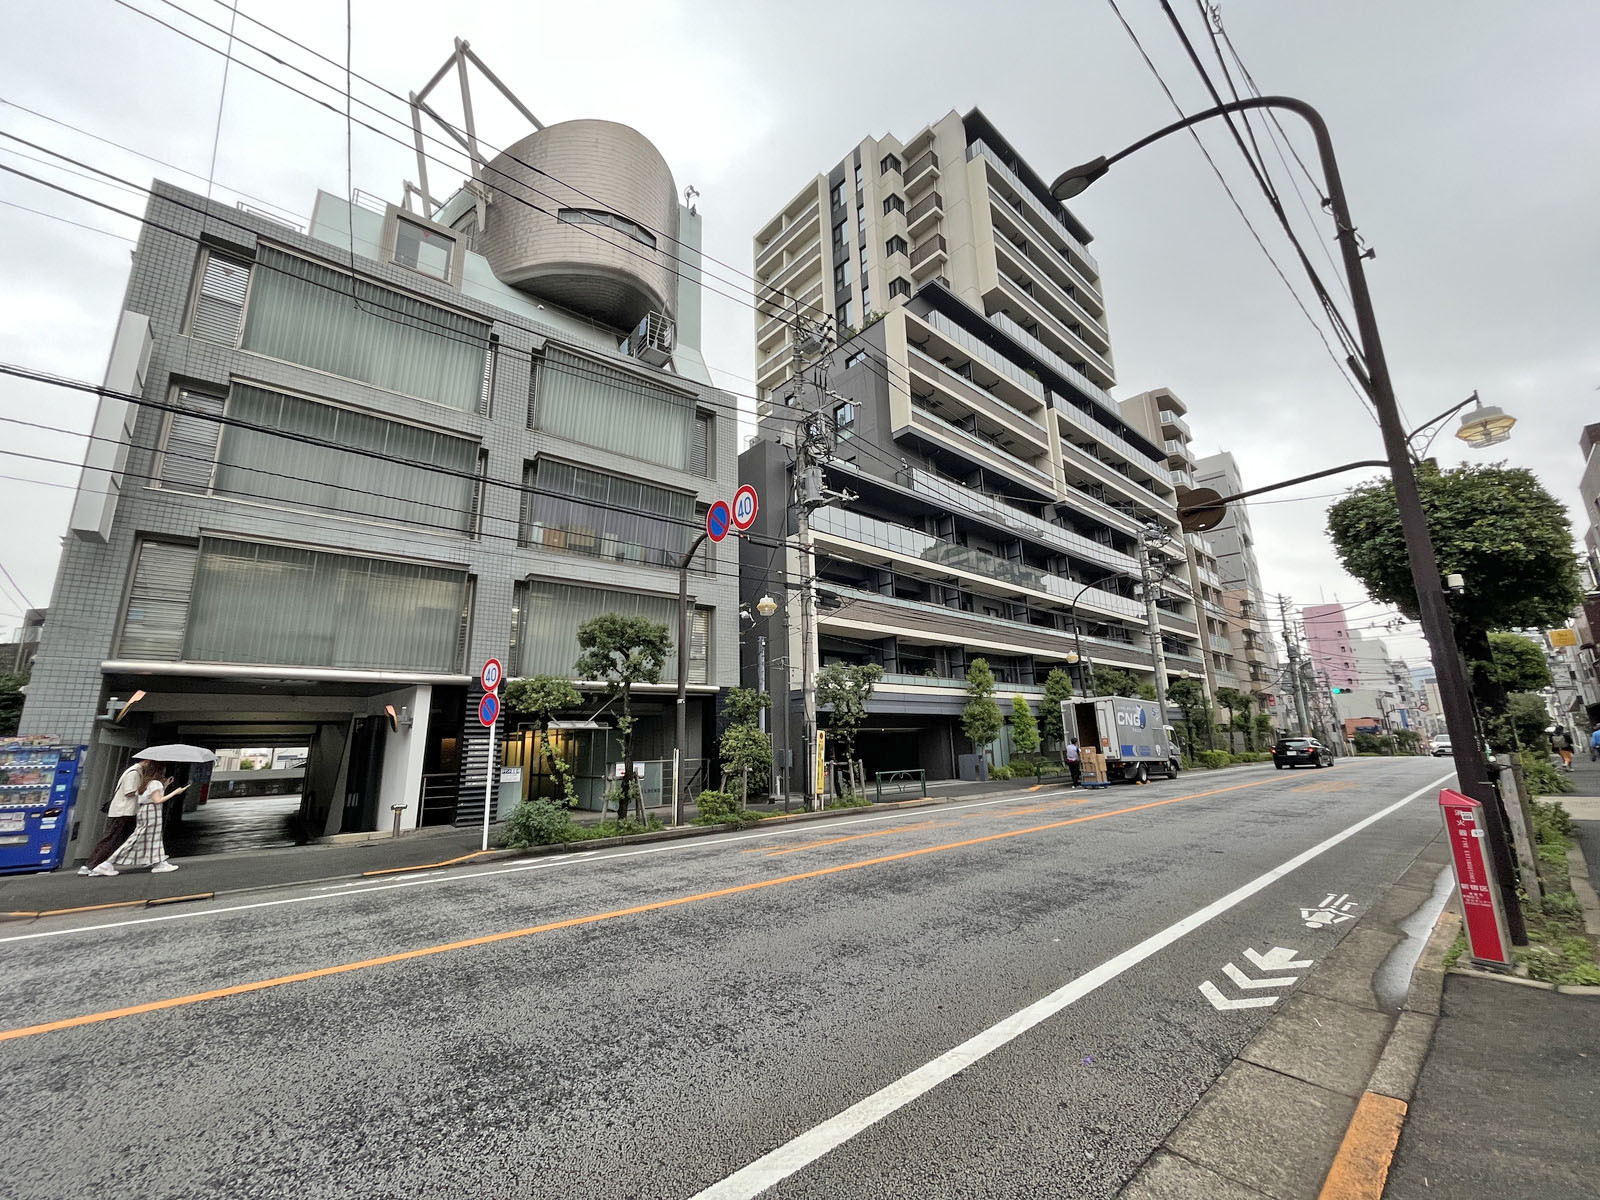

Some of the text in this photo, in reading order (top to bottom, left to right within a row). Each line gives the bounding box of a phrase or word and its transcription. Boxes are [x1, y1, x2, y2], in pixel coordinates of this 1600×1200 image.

[737, 496, 752, 519] 40
[485, 663, 497, 682] 40
[1117, 711, 1141, 727] CNG
